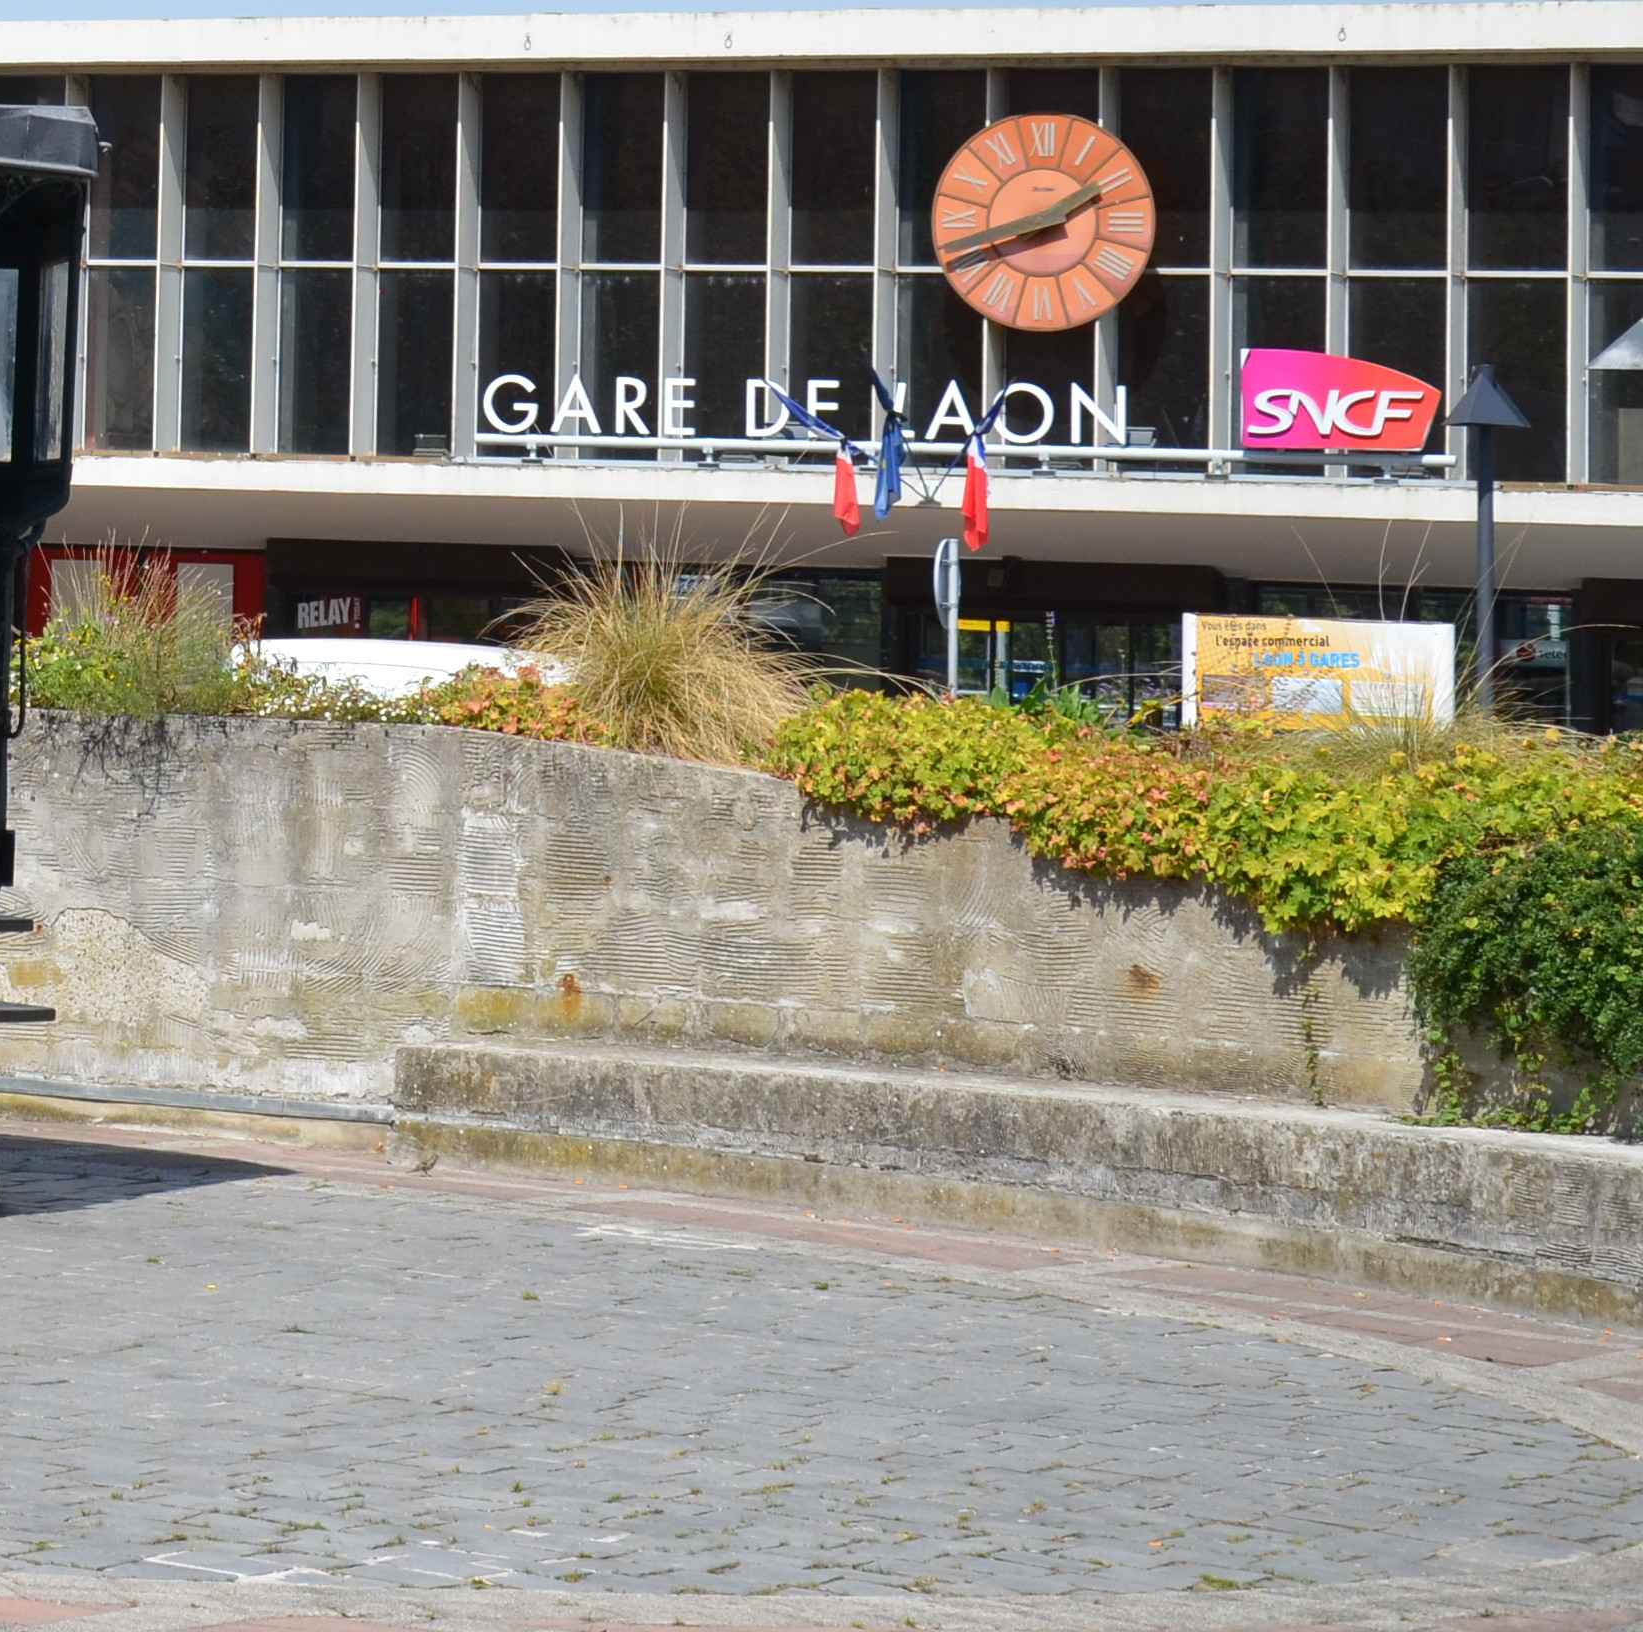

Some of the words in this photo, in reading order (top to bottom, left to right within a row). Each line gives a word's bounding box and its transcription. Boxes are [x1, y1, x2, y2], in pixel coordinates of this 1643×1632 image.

[483, 374, 696, 435] GARE
[746, 378, 840, 438] DE
[1247, 389, 1424, 436] SNCF
[298, 597, 351, 628] RELAY
[1202, 621, 1222, 631] Vous
[1246, 620, 1267, 631] dans
[1262, 635, 1330, 647] commercial
[1310, 652, 1360, 668] GARES
